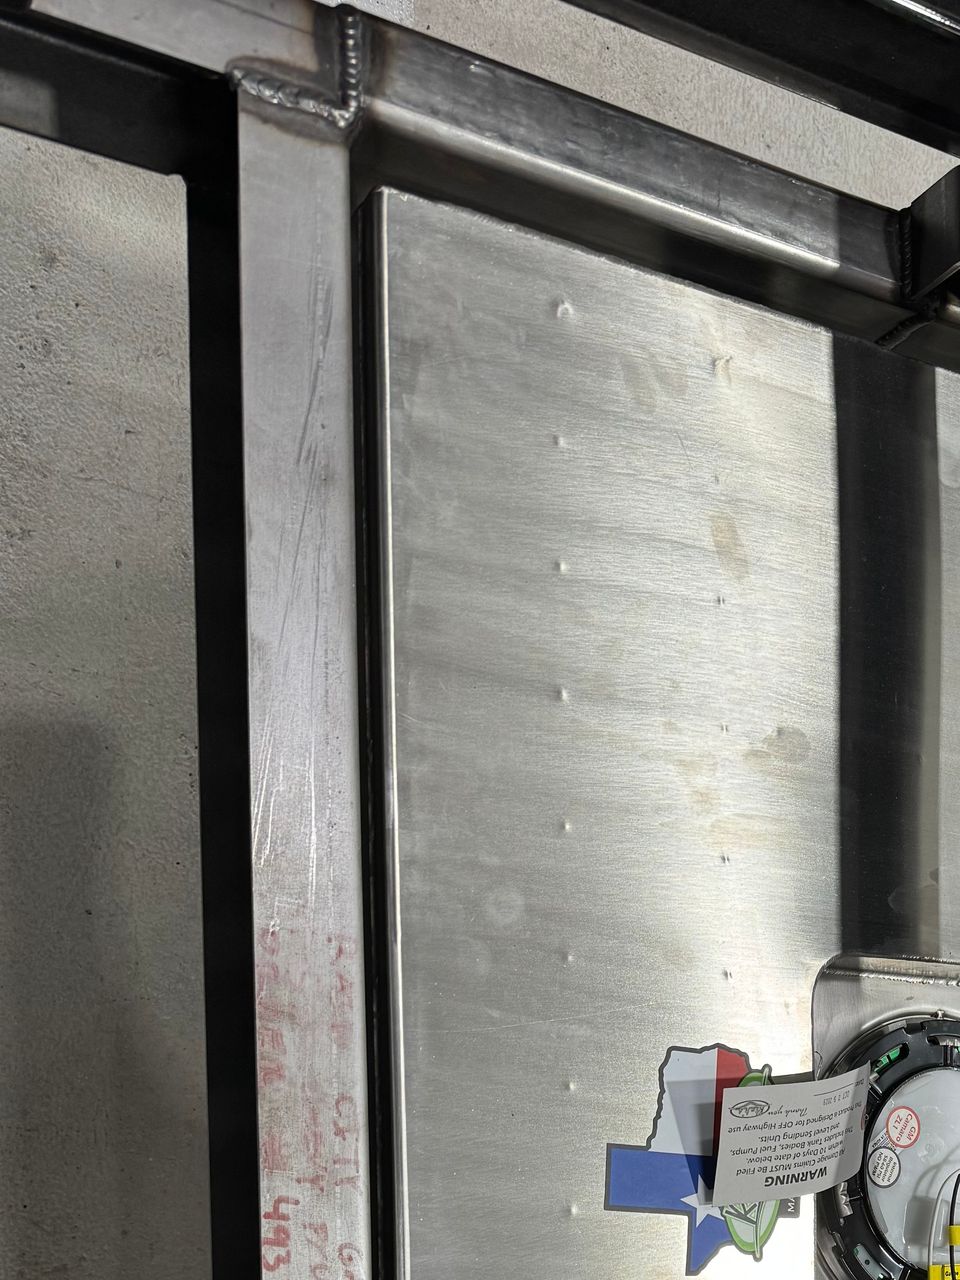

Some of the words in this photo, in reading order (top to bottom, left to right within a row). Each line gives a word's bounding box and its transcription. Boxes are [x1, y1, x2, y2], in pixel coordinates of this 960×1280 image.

[768, 1105, 783, 1115] you
[785, 1108, 808, 1118] Thank
[794, 1120, 805, 1128] for
[806, 1113, 833, 1126] Designed
[742, 1122, 776, 1132] Highway
[778, 1121, 793, 1129] OFF
[894, 1112, 914, 1143] Camaro
[728, 1126, 741, 1134] use
[814, 1126, 829, 1134] Level
[905, 1125, 917, 1141] GM
[783, 1130, 812, 1140] Sending
[779, 1142, 806, 1151] Bodies,
[807, 1138, 823, 1146] Tank
[730, 1147, 758, 1156] Pumps,
[759, 1145, 777, 1154] Fuel
[802, 1148, 818, 1157] Days
[820, 1146, 826, 1154] 10
[746, 1156, 772, 1164] below.
[774, 1153, 791, 1161] date
[817, 1151, 839, 1164] Damage
[769, 1163, 792, 1172] MUST
[794, 1160, 816, 1169] Claims
[736, 1167, 755, 1176] Filed
[757, 1166, 768, 1174] Be
[764, 1167, 828, 1187] WARNING
